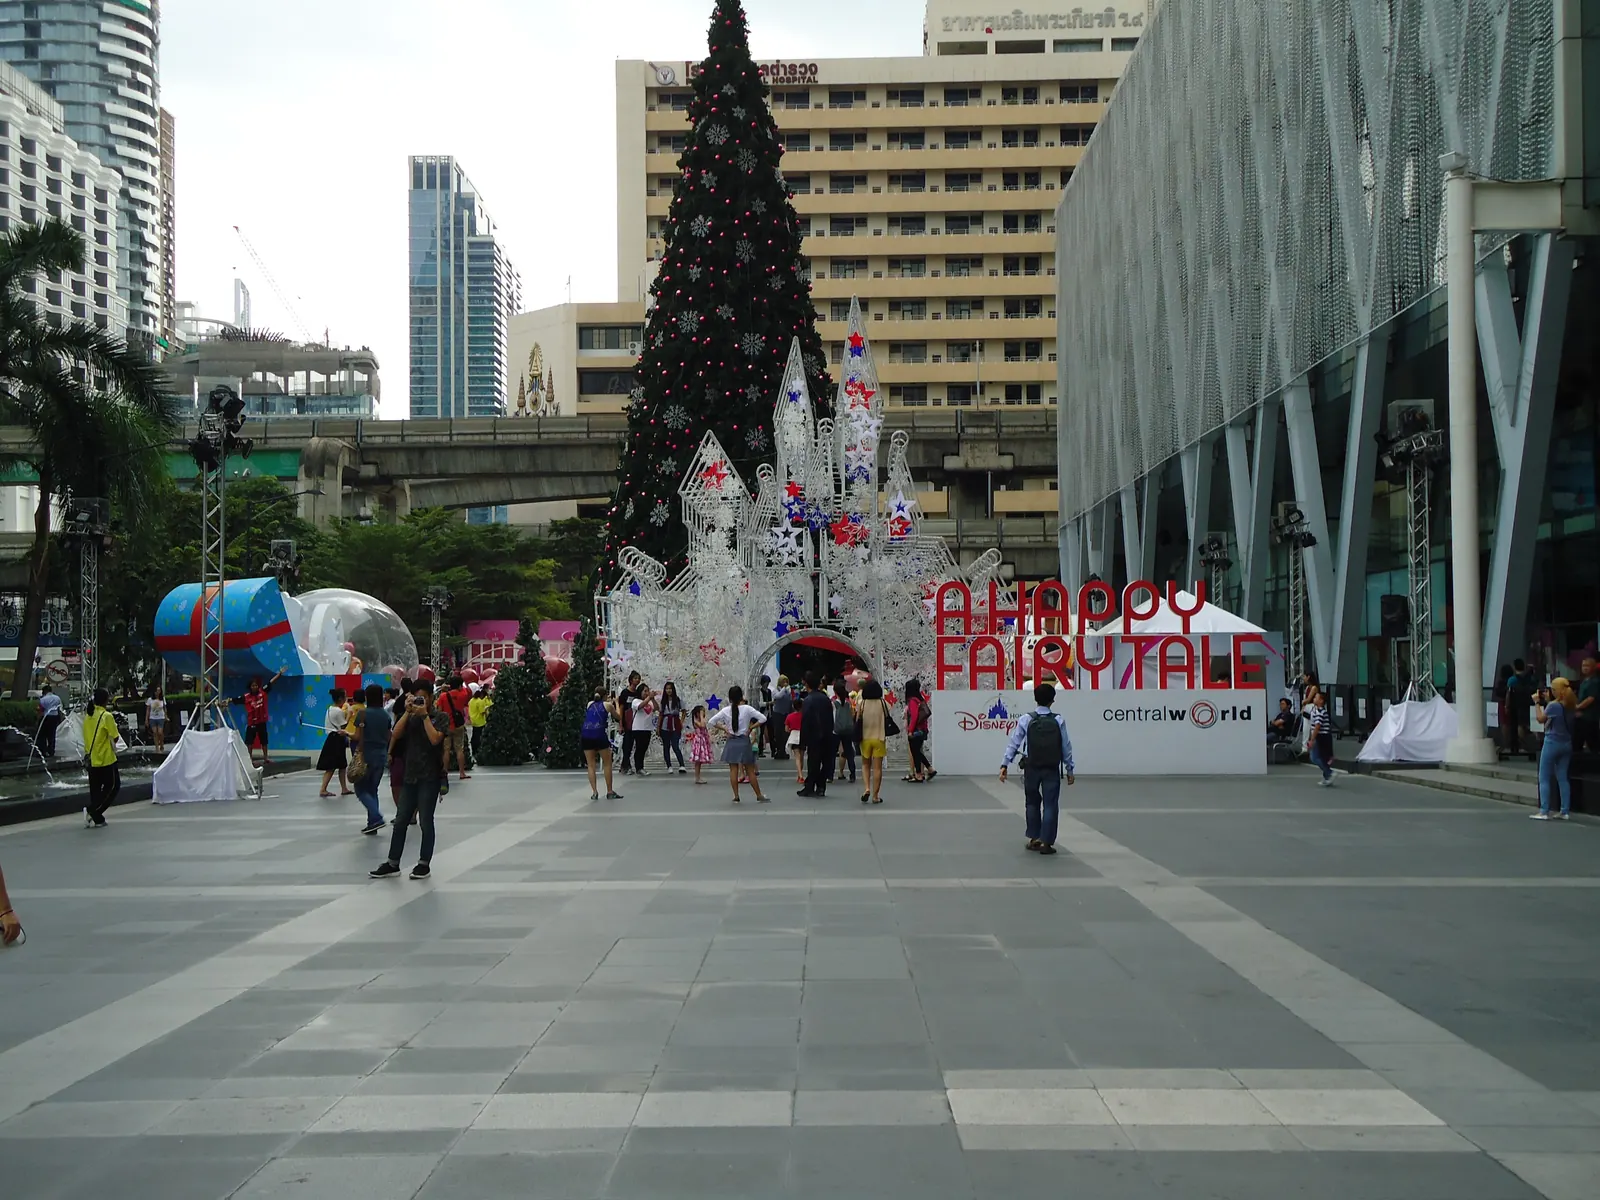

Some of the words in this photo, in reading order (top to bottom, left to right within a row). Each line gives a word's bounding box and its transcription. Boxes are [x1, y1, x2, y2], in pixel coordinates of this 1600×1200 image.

[772, 76, 818, 84] HOSPITAL
[936, 580, 972, 635] A
[988, 580, 1205, 635] HAPPY
